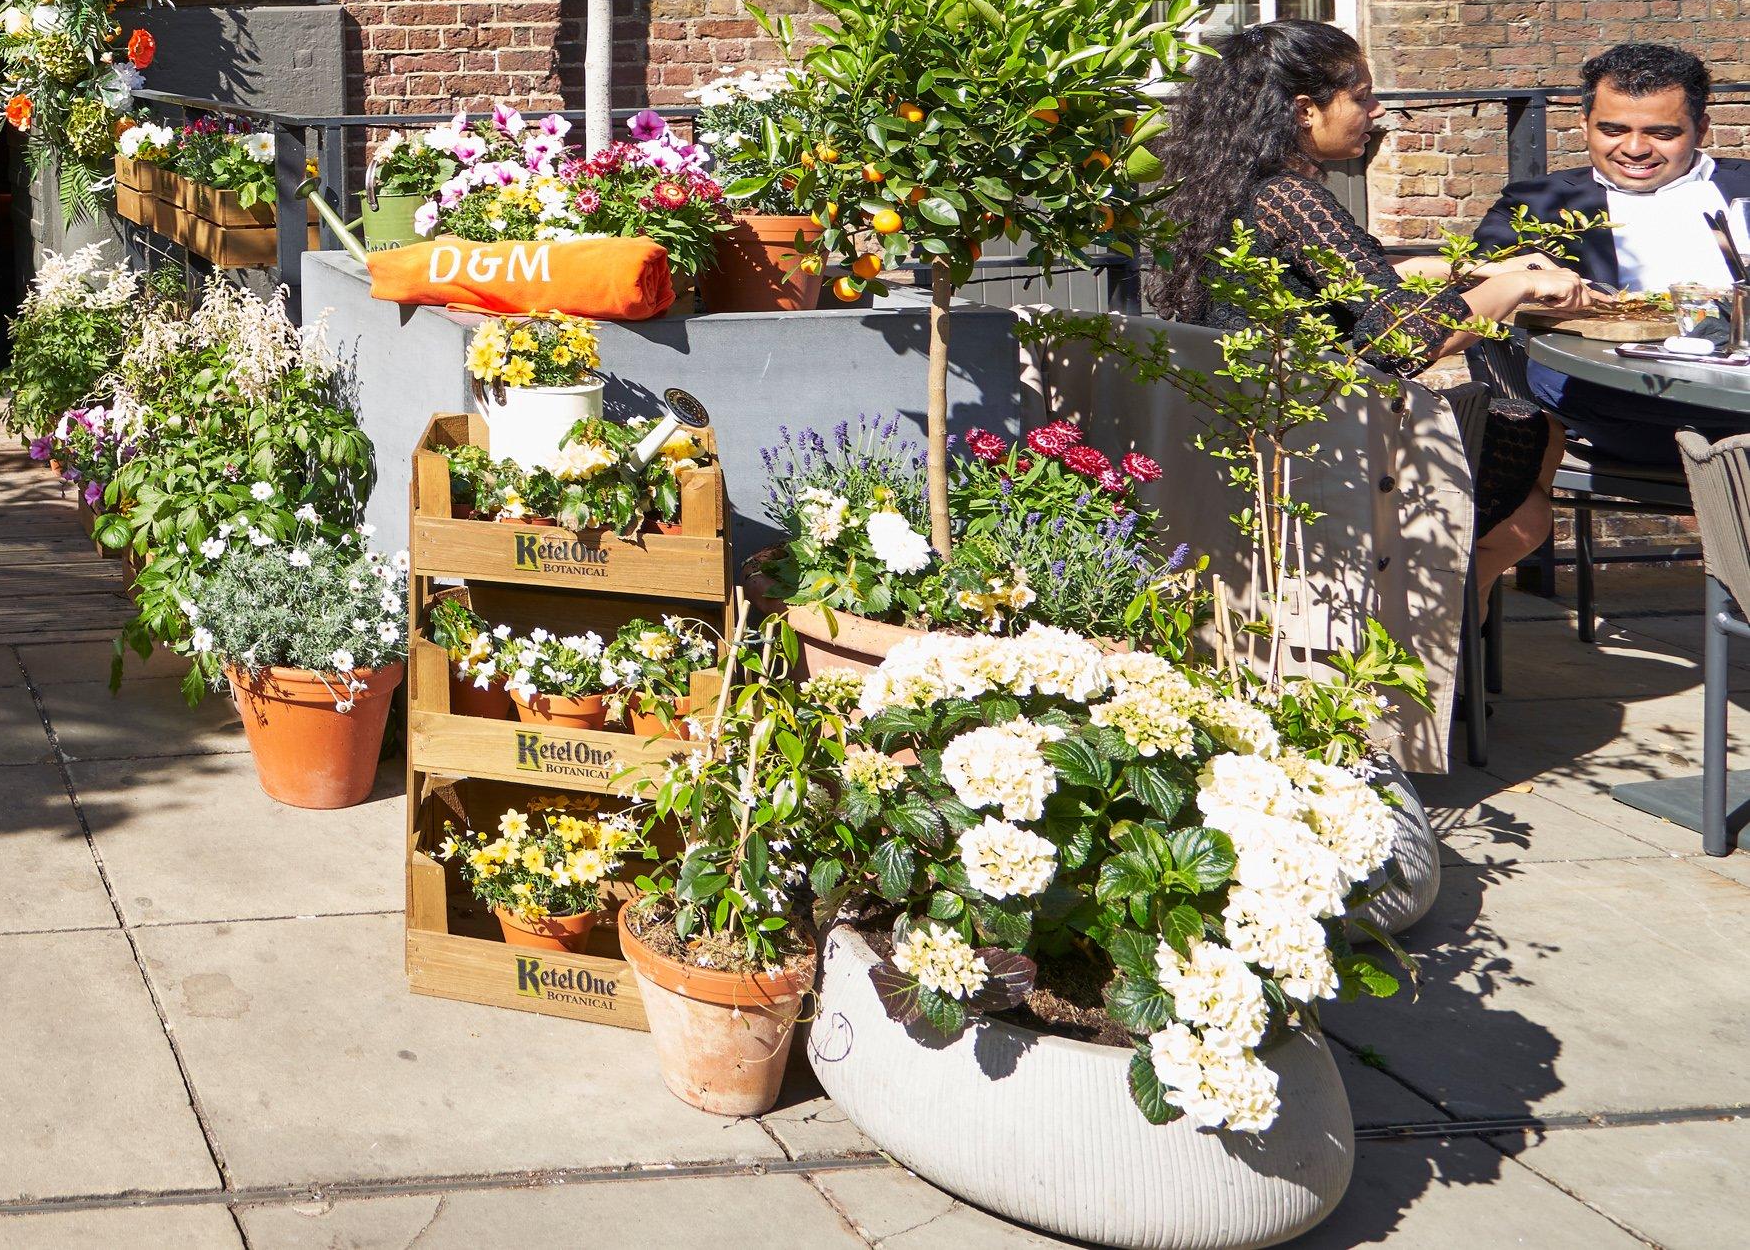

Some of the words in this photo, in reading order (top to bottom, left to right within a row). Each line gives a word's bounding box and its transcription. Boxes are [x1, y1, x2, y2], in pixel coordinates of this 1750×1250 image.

[428, 244, 551, 284] D&M
[543, 563, 609, 578] BOTANICAL
[546, 990, 617, 1011] BOTANICAL
